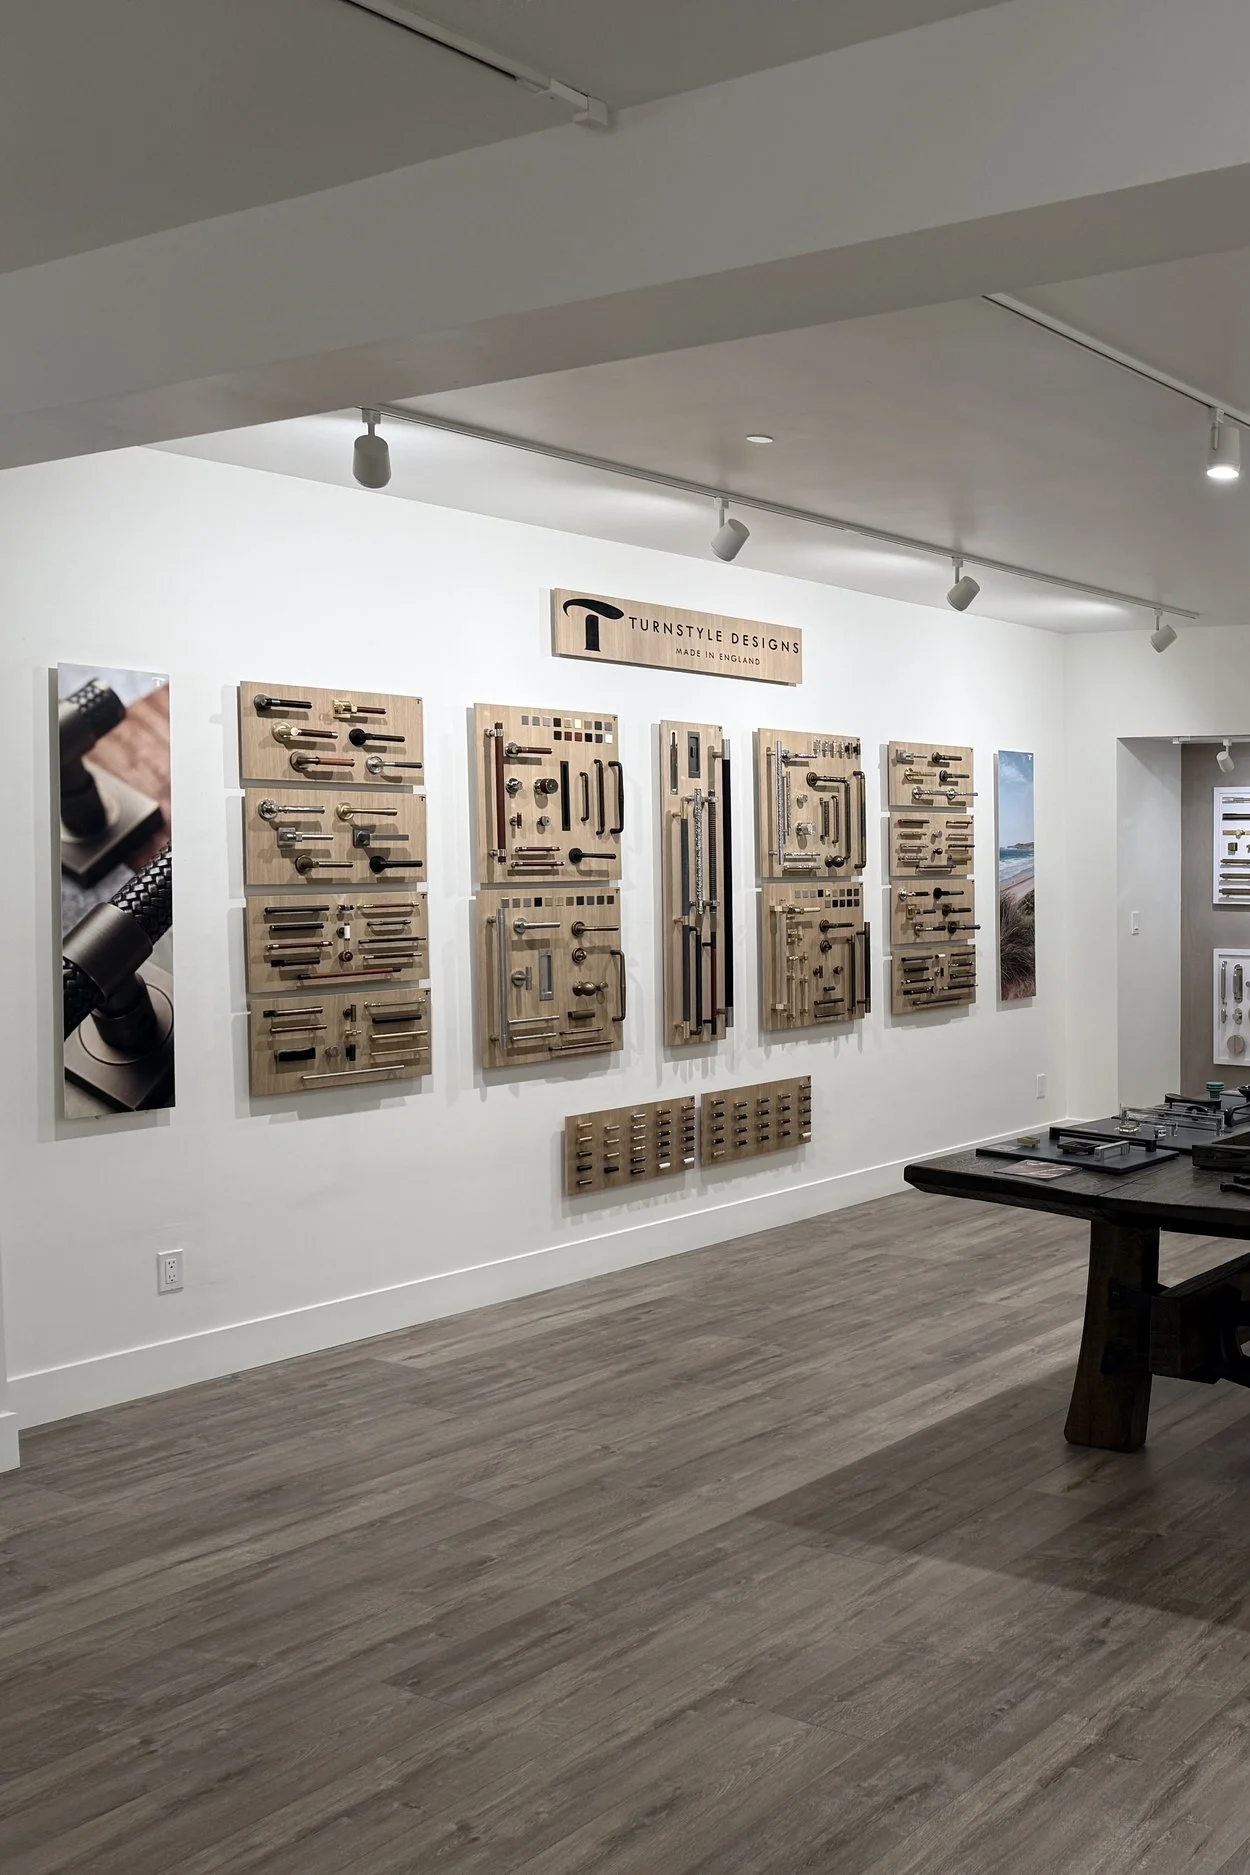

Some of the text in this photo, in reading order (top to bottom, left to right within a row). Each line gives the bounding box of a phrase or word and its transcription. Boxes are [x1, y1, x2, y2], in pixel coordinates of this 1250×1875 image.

[628, 616, 800, 655] TURNSTYLE DESIGNS
[675, 647, 761, 666] MADE IN ENGLAND
